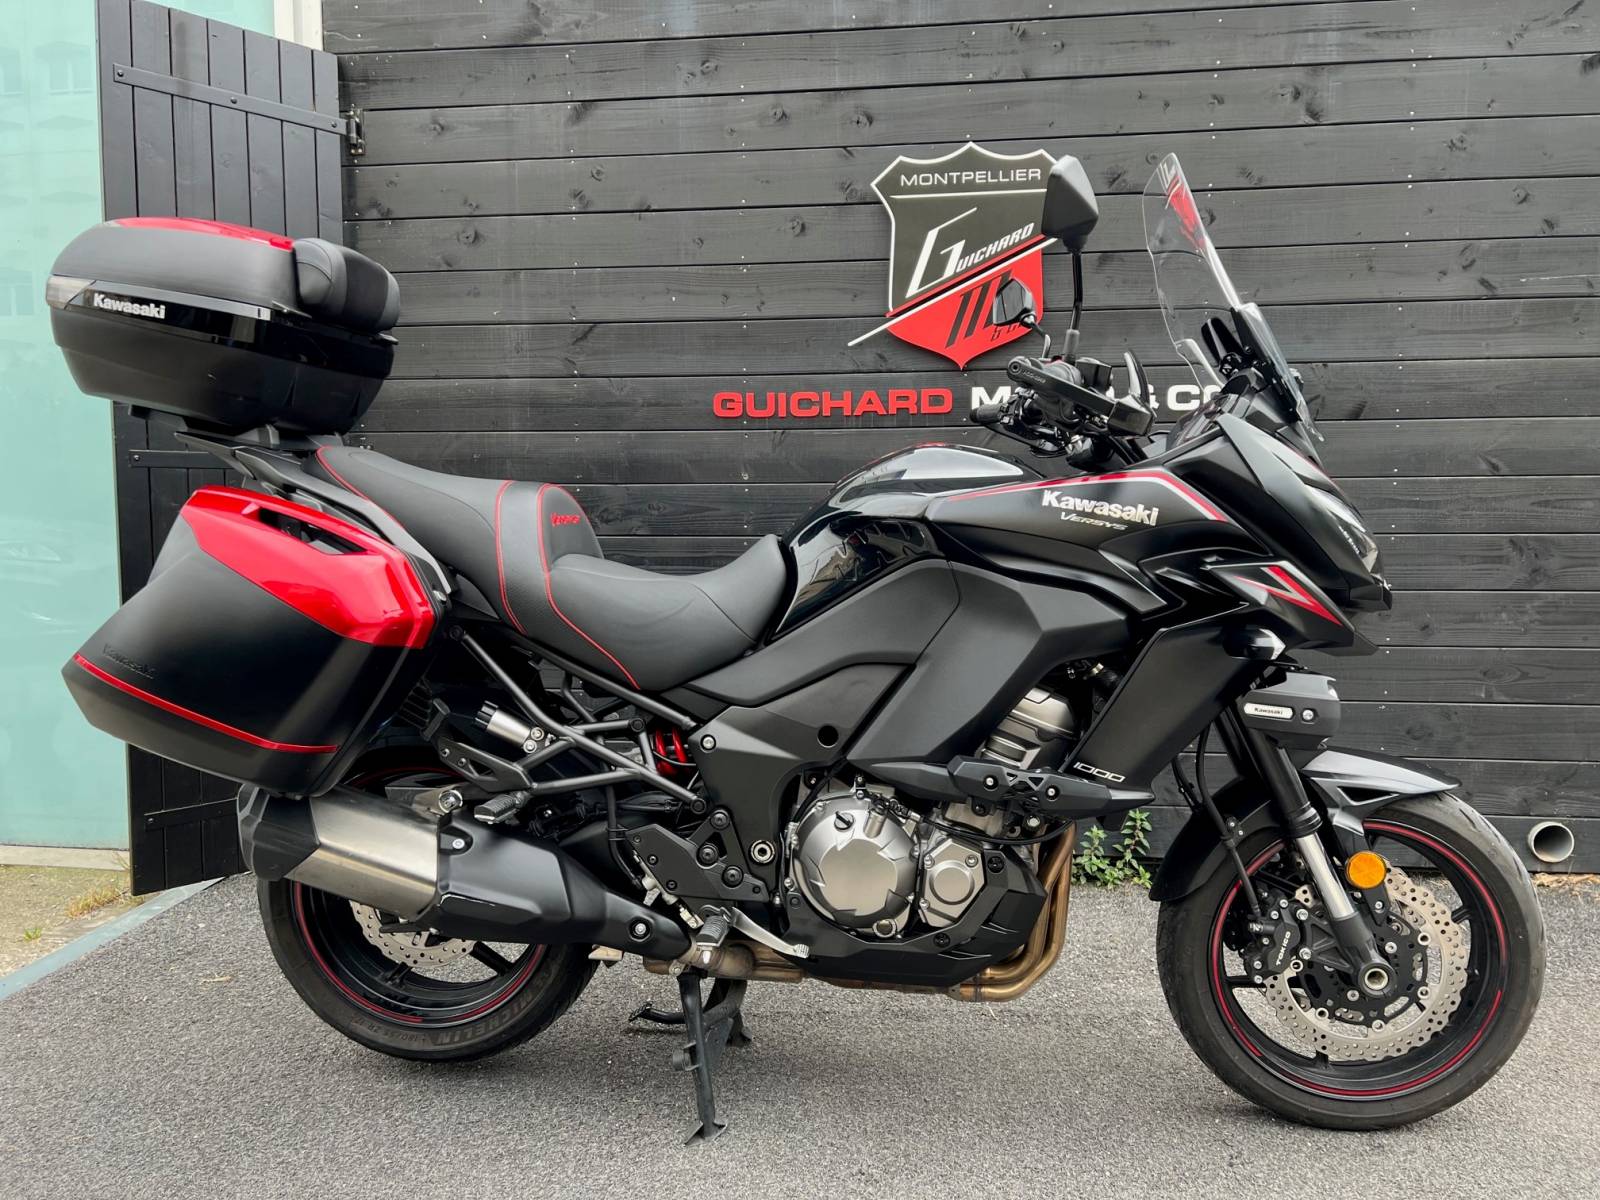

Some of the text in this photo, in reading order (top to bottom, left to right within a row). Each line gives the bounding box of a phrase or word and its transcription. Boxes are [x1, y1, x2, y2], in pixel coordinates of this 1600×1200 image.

[901, 168, 1042, 187] MONTPELLIER
[93, 292, 166, 320] Kawasaki
[712, 388, 954, 419] GUICHARD
[1041, 489, 1160, 527] Kawasaki
[1073, 761, 1126, 783] 1000
[1275, 931, 1292, 966] TOKICO
[436, 991, 534, 1045] MICHELIN
